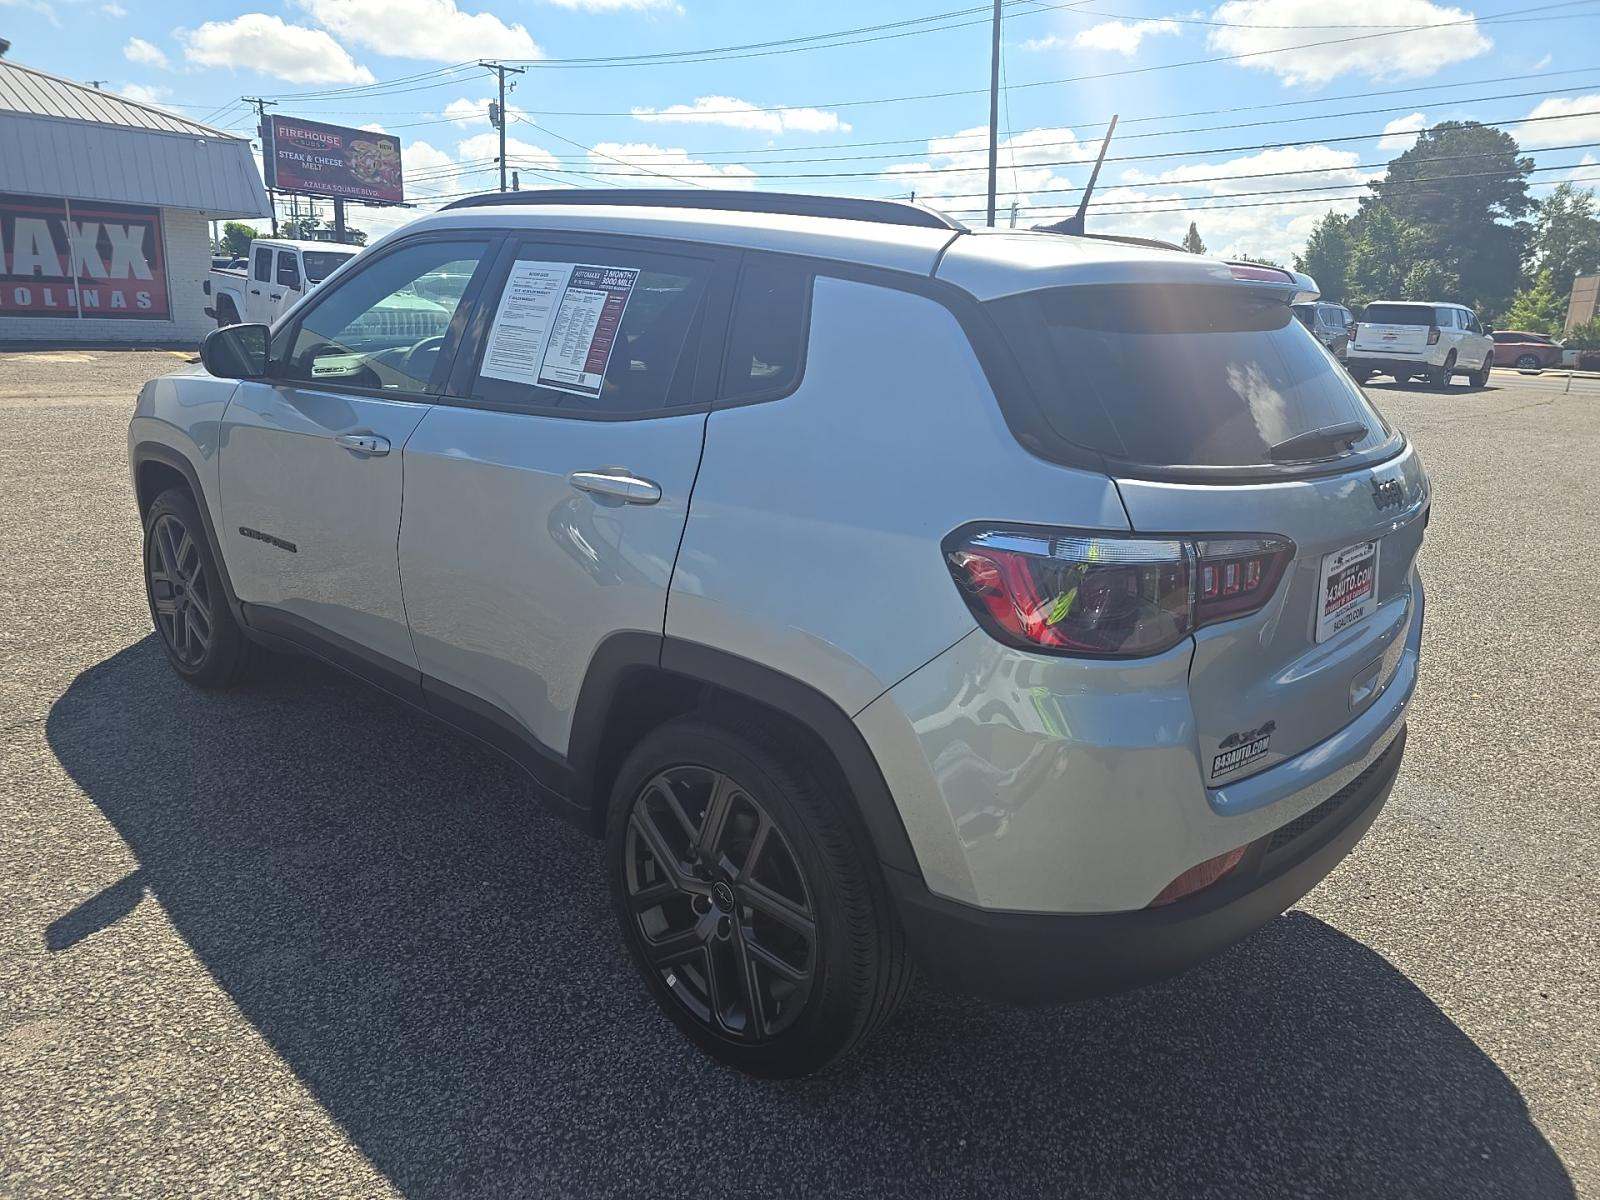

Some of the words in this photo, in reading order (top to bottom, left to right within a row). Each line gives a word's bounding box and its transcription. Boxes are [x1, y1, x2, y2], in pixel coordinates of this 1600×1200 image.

[279, 127, 340, 146] FIREHOUSE
[279, 151, 305, 161] STEAK
[306, 155, 313, 163] &
[314, 157, 343, 167] CHEESE
[302, 162, 322, 171] MELT
[303, 181, 331, 191] AZALEA
[333, 185, 359, 195] SQUARE
[0, 217, 154, 280] AXX
[0, 287, 152, 309] OLINAS
[1214, 736, 1270, 771] 843AUTO.COM
